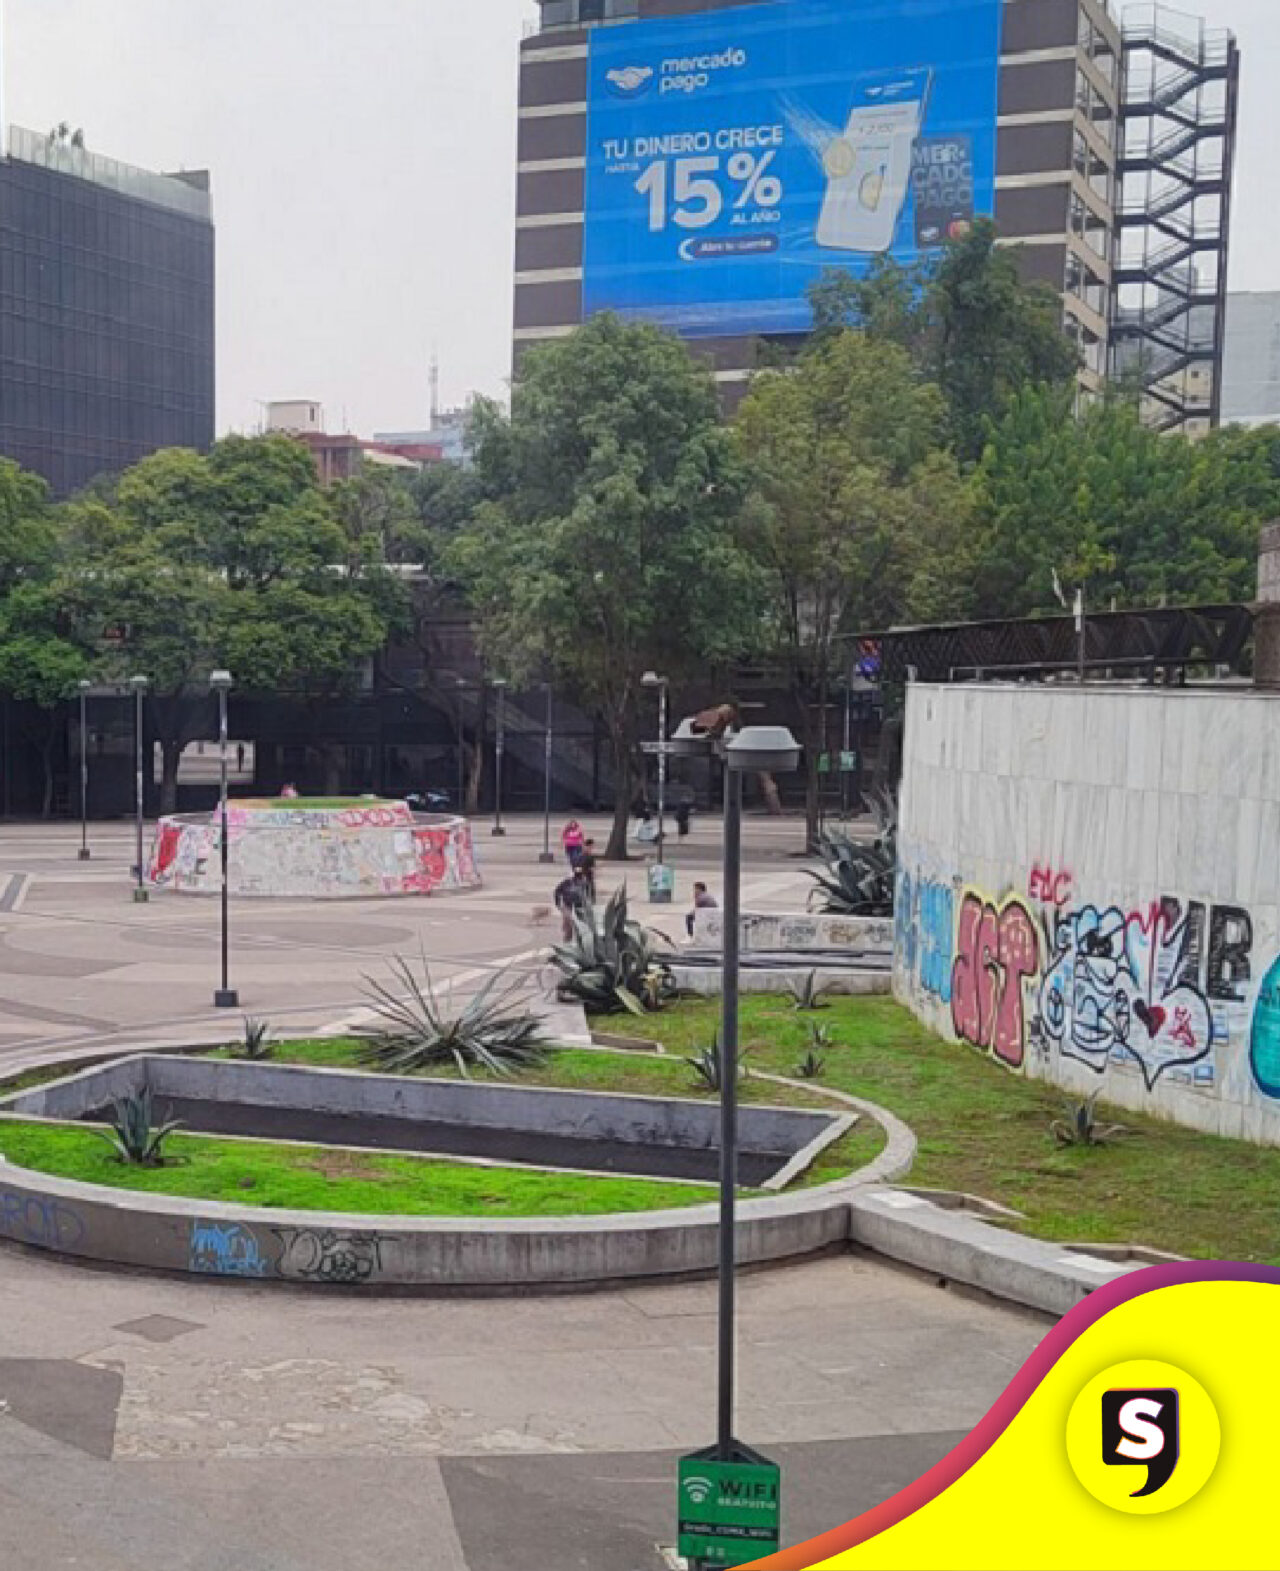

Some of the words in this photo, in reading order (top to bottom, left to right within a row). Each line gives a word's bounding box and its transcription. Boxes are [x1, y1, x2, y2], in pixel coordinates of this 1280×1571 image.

[662, 47, 746, 73] mercado
[661, 73, 709, 94] pago
[602, 137, 628, 160] TU
[634, 131, 711, 158] DINERO
[716, 124, 785, 150] CRECE
[634, 150, 783, 233] 15%
